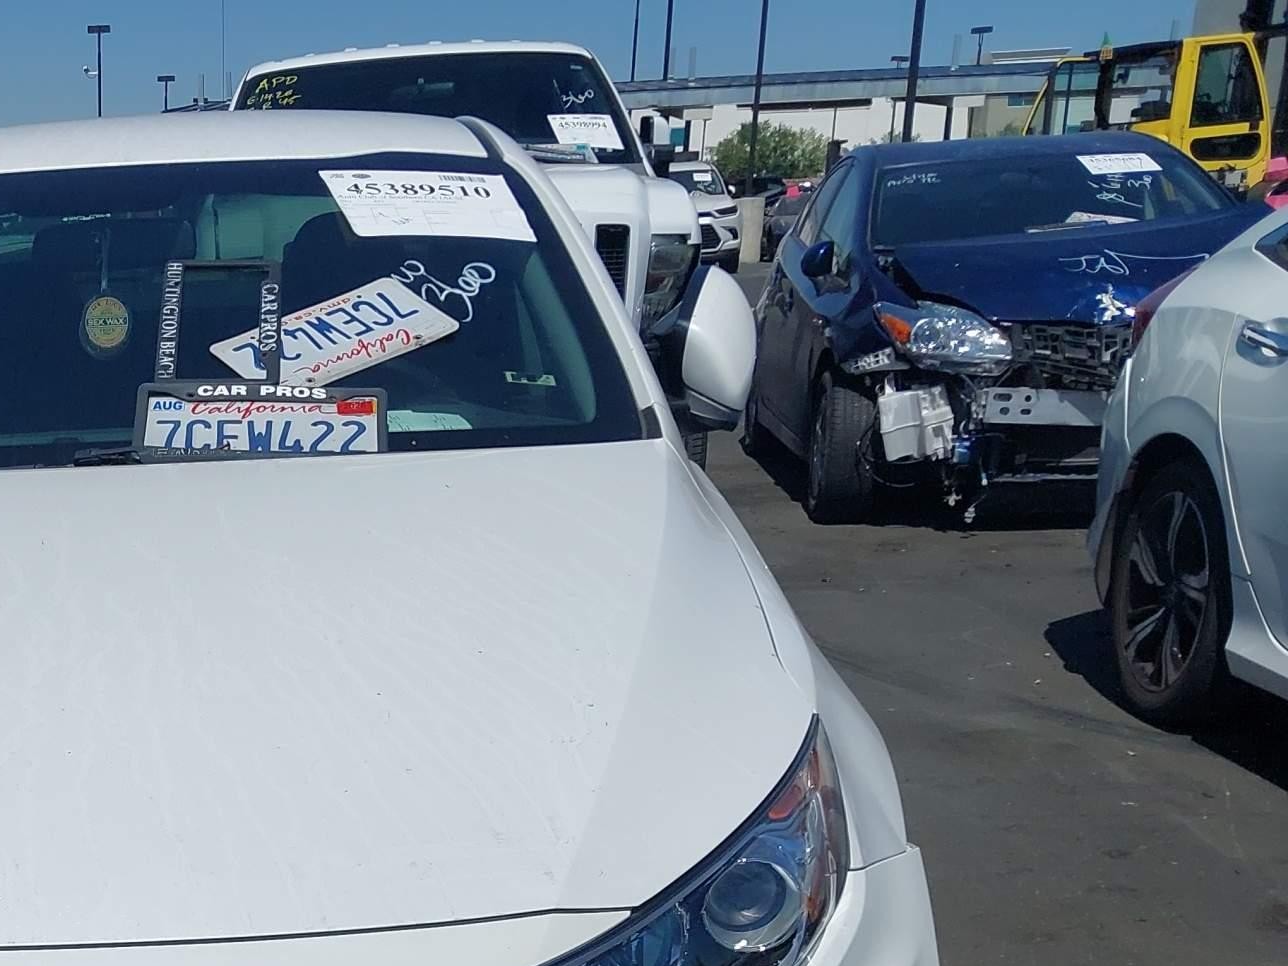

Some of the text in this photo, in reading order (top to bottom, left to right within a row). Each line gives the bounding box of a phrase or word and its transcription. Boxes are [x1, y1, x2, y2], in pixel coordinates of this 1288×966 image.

[345, 182, 492, 199] 45389510
[157, 262, 183, 379] HUNTINGTON BEACH
[259, 283, 280, 352] CAR PROS
[197, 385, 327, 399] CAR PROS
[152, 400, 184, 411] AUG
[191, 401, 330, 420] California
[156, 419, 367, 453] 7CEW422
